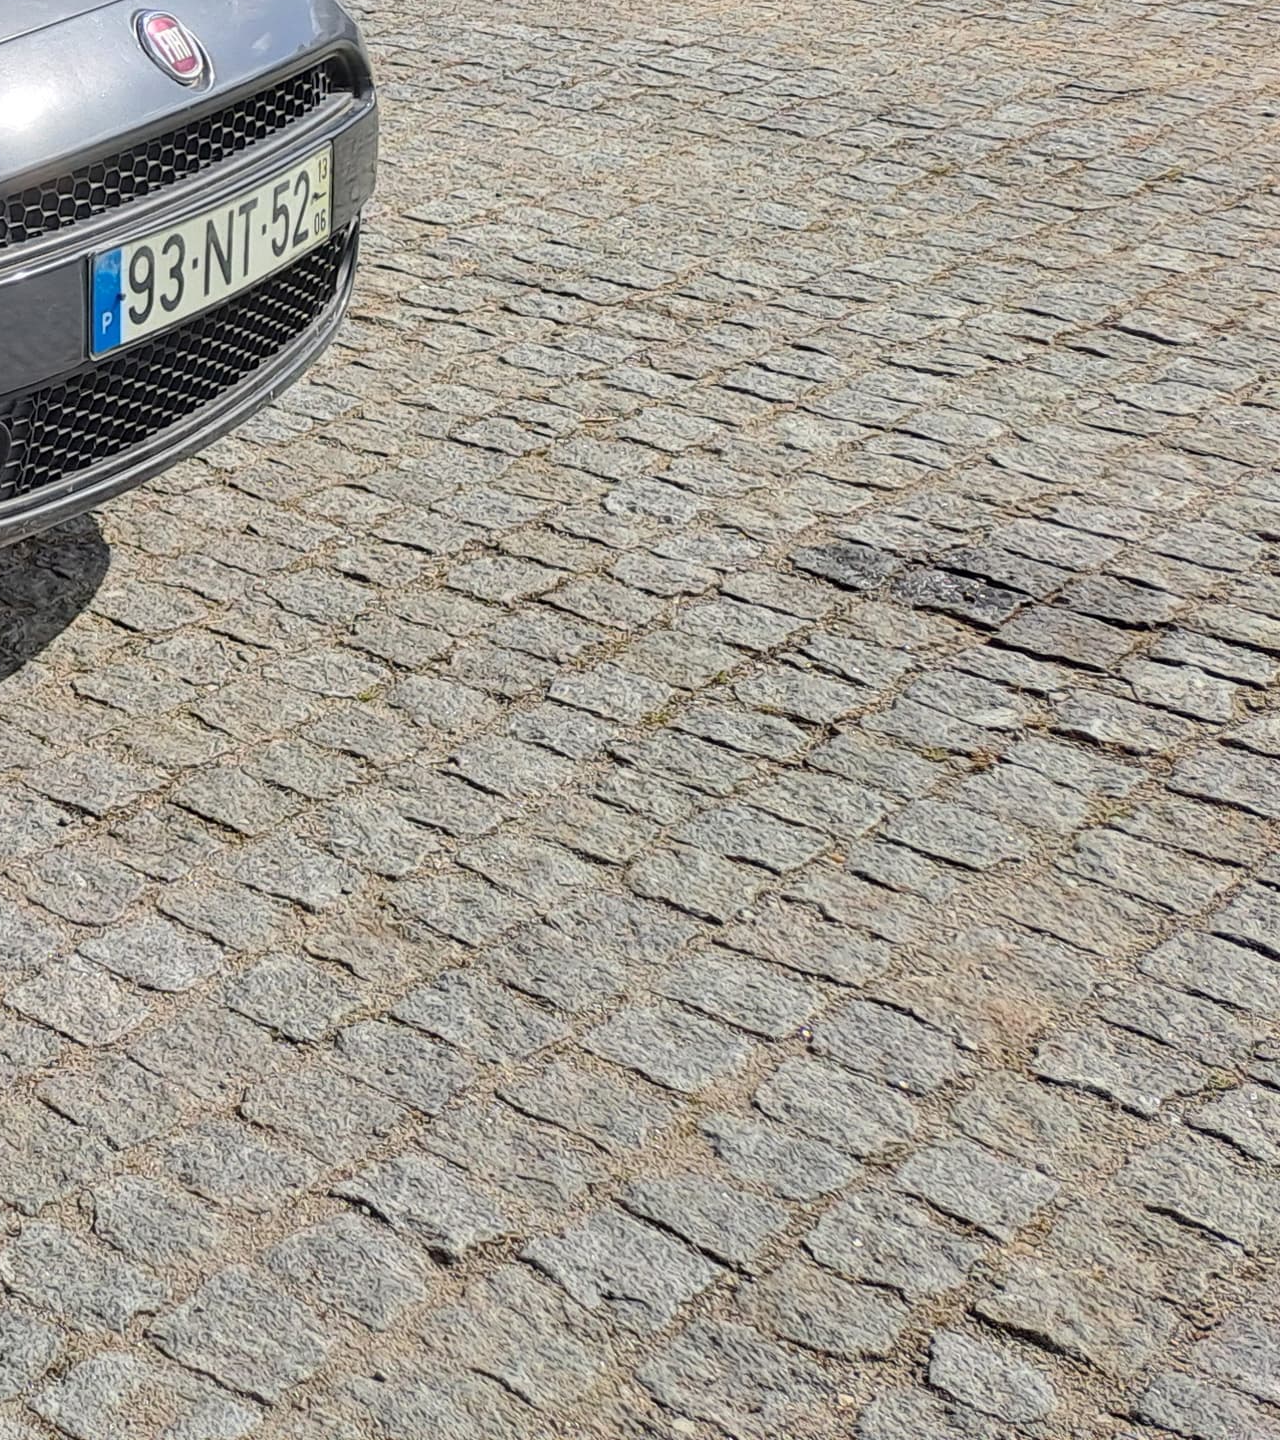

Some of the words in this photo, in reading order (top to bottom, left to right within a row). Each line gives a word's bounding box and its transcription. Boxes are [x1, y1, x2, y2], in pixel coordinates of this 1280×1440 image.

[317, 158, 328, 183] 13
[313, 208, 327, 236] 06
[102, 311, 113, 334] P
